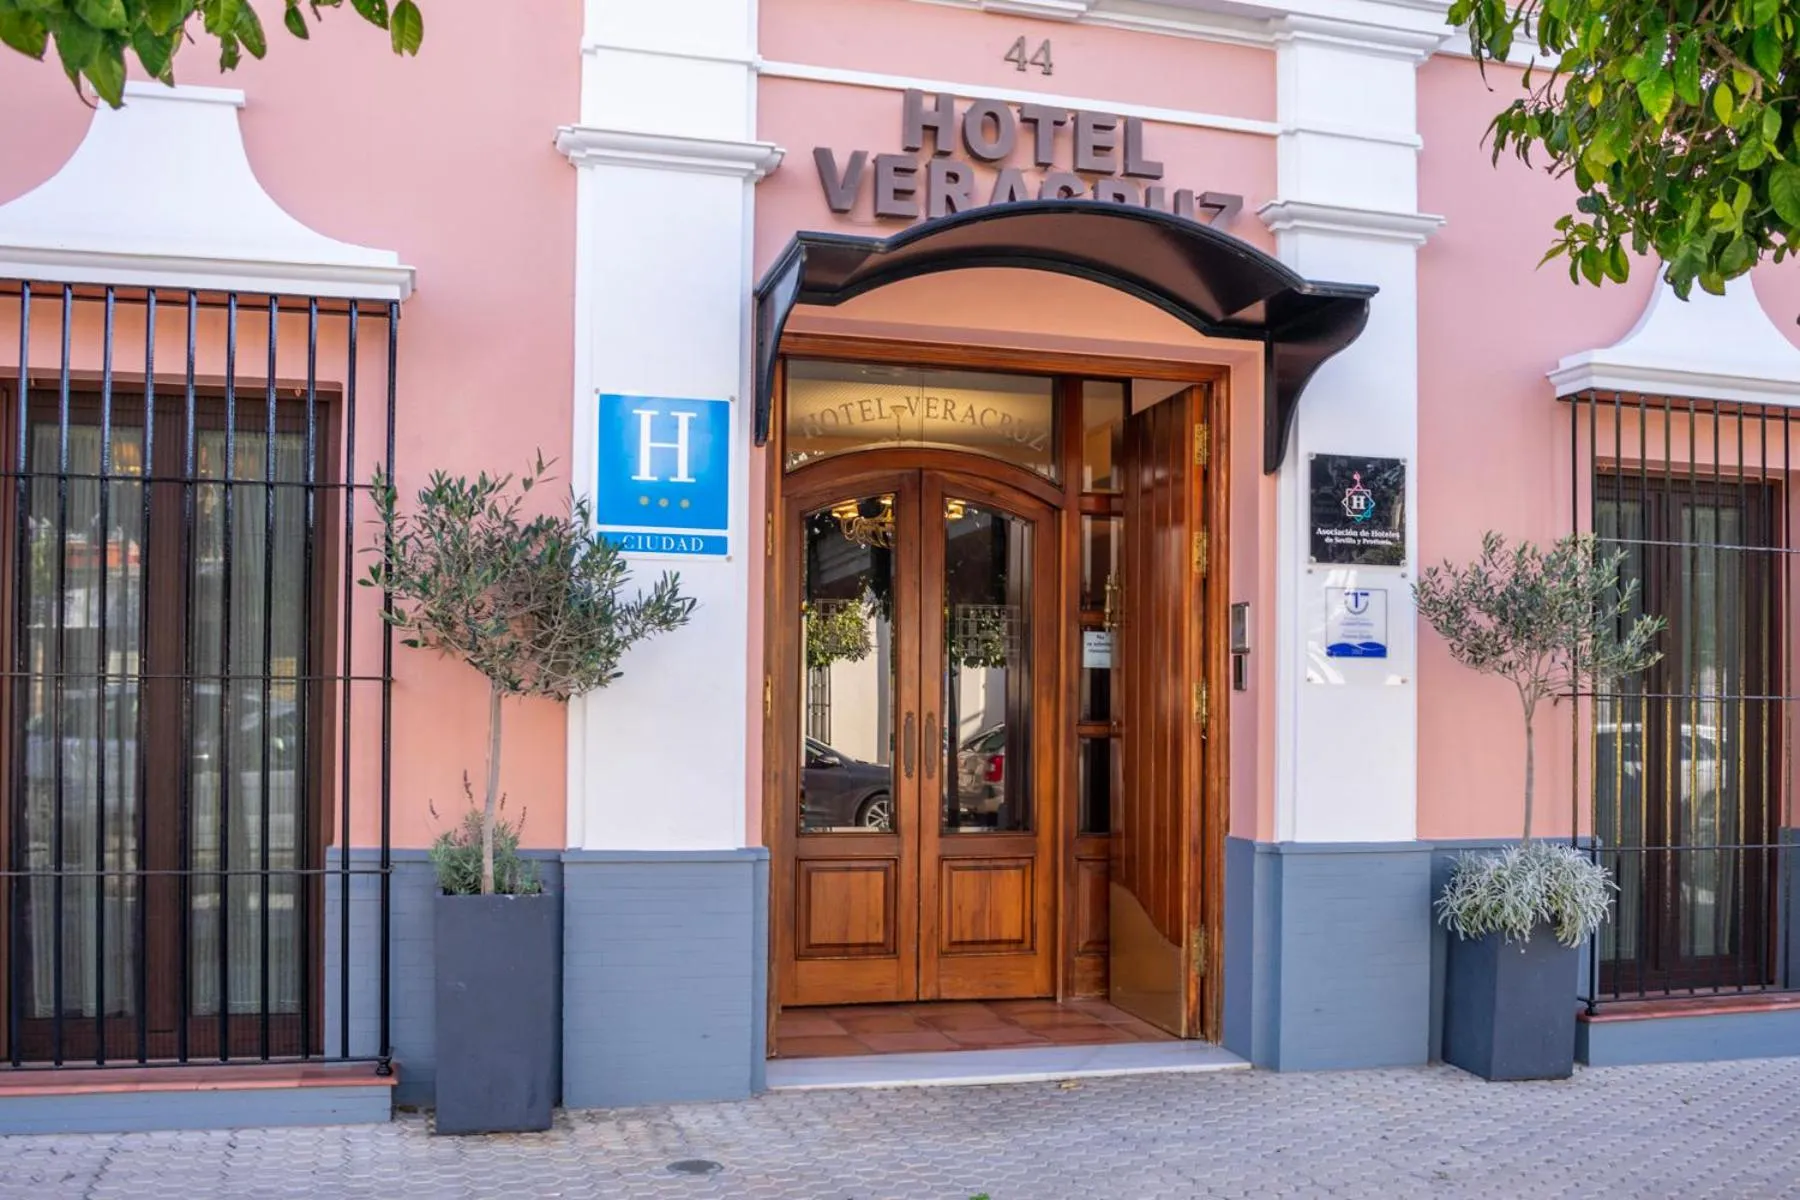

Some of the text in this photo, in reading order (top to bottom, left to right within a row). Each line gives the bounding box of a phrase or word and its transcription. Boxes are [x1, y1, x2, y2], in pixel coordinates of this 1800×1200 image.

[1003, 34, 1054, 76] 44
[902, 88, 1164, 180] HOTEL
[799, 397, 892, 439] HOTEL
[631, 409, 698, 483] H
[622, 534, 704, 551] CIUDAD
